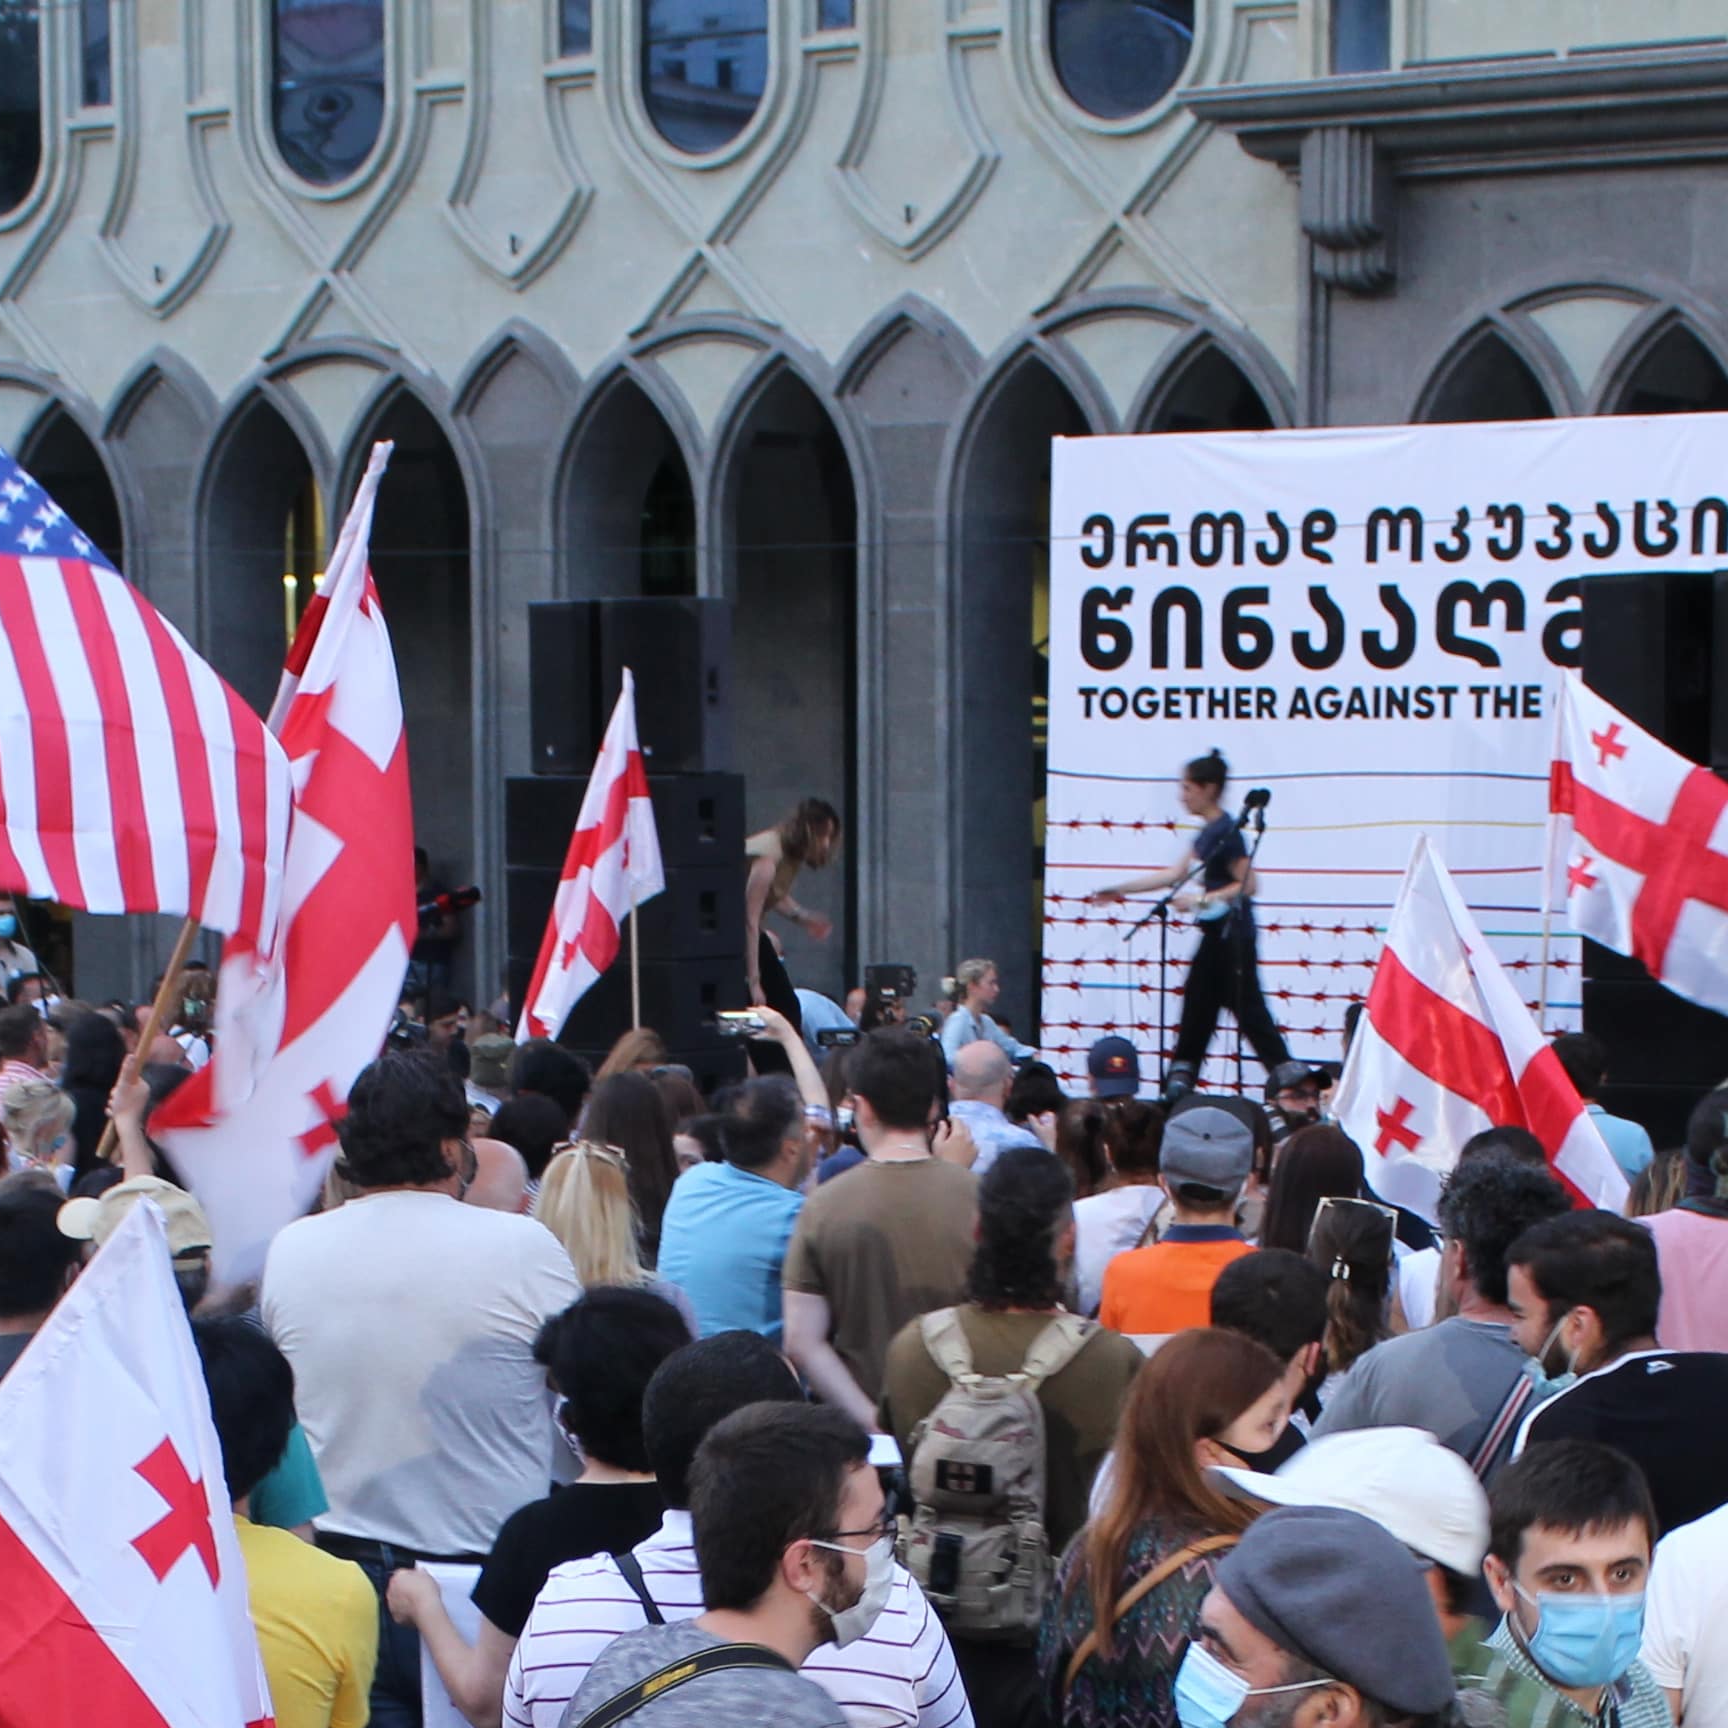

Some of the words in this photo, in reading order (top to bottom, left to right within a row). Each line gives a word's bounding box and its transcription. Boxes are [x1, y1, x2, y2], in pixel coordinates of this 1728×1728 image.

[1081, 509, 1338, 568] ერთად
[1078, 686, 1278, 720] TOGETHER
[1288, 685, 1459, 720] AGAINST
[1469, 685, 1542, 720] THE
